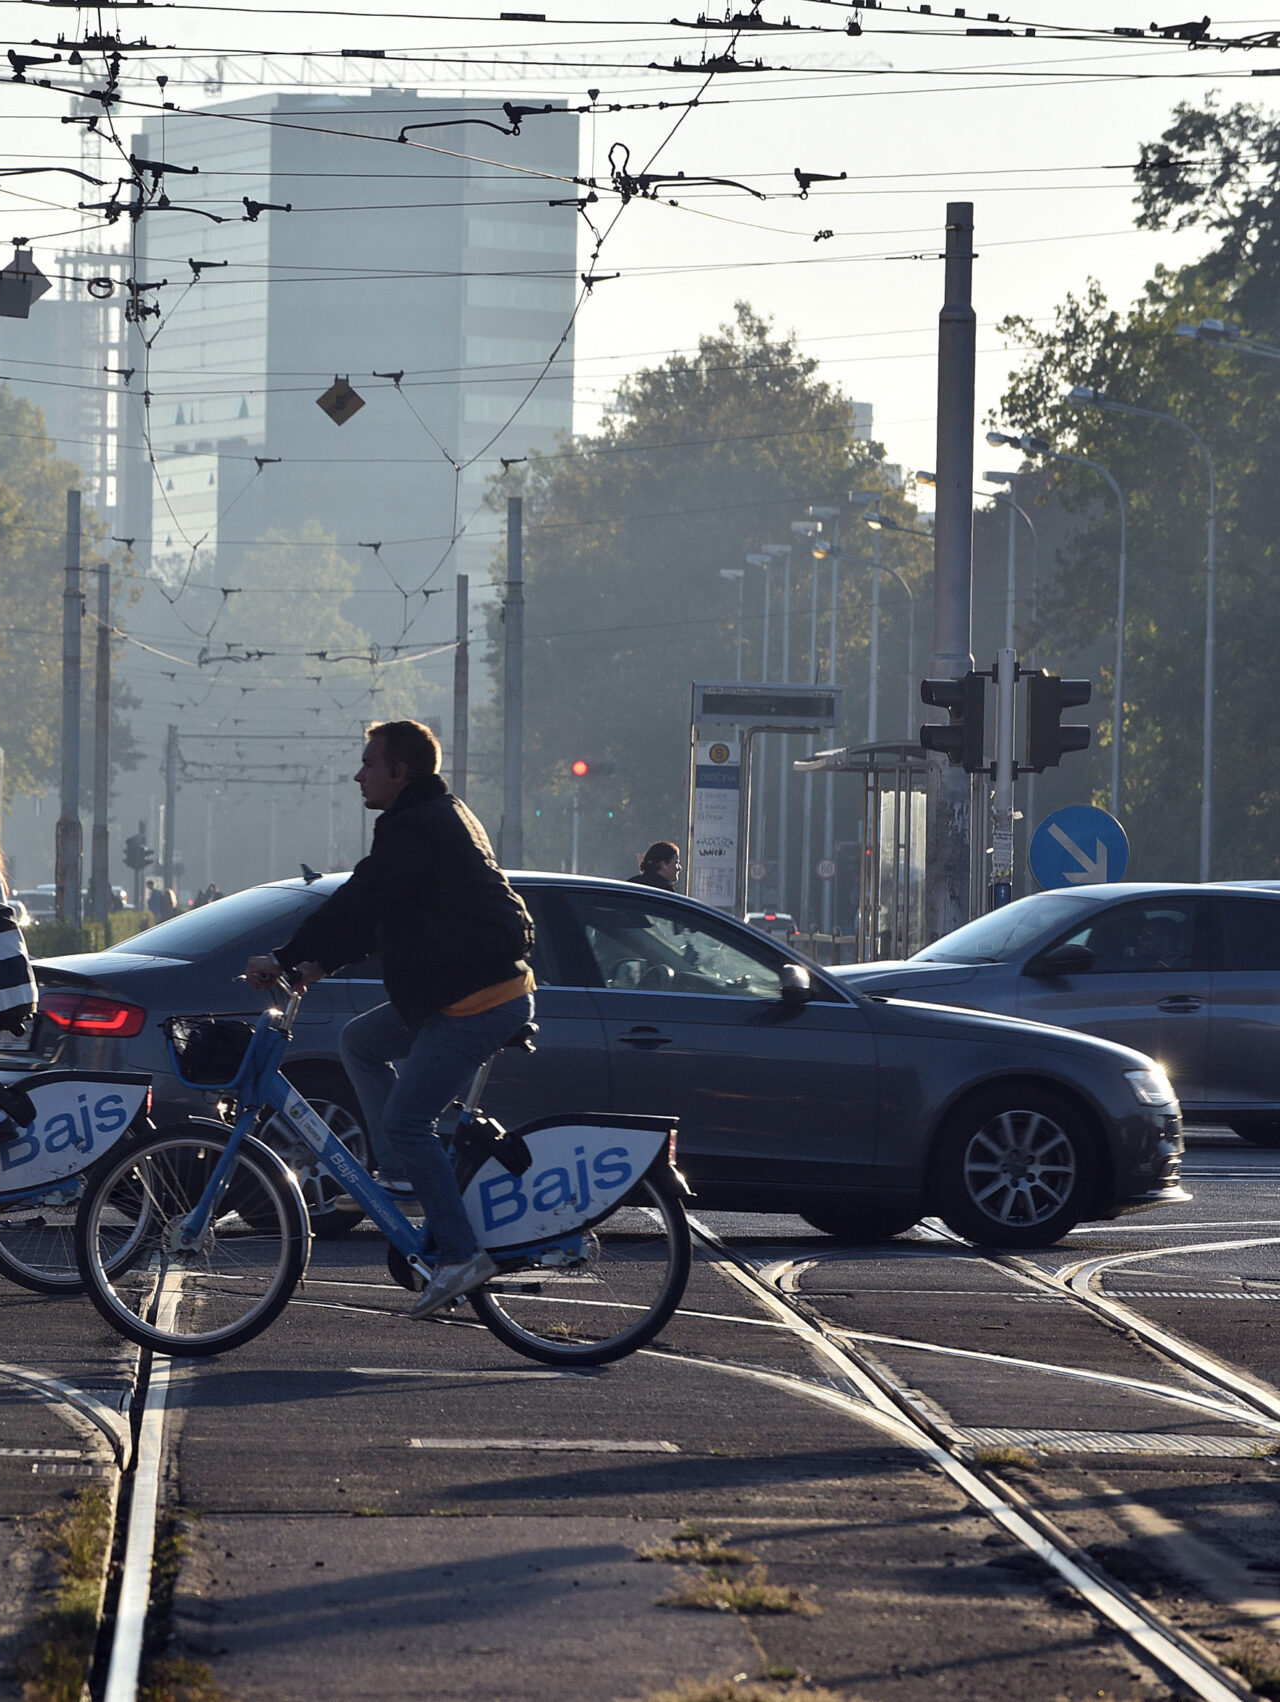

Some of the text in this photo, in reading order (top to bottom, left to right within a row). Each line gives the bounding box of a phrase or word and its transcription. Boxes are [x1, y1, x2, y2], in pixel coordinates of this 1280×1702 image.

[0, 1094, 127, 1171] Bajs
[330, 1152, 359, 1184] Bajs
[479, 1146, 632, 1232] Bajs
